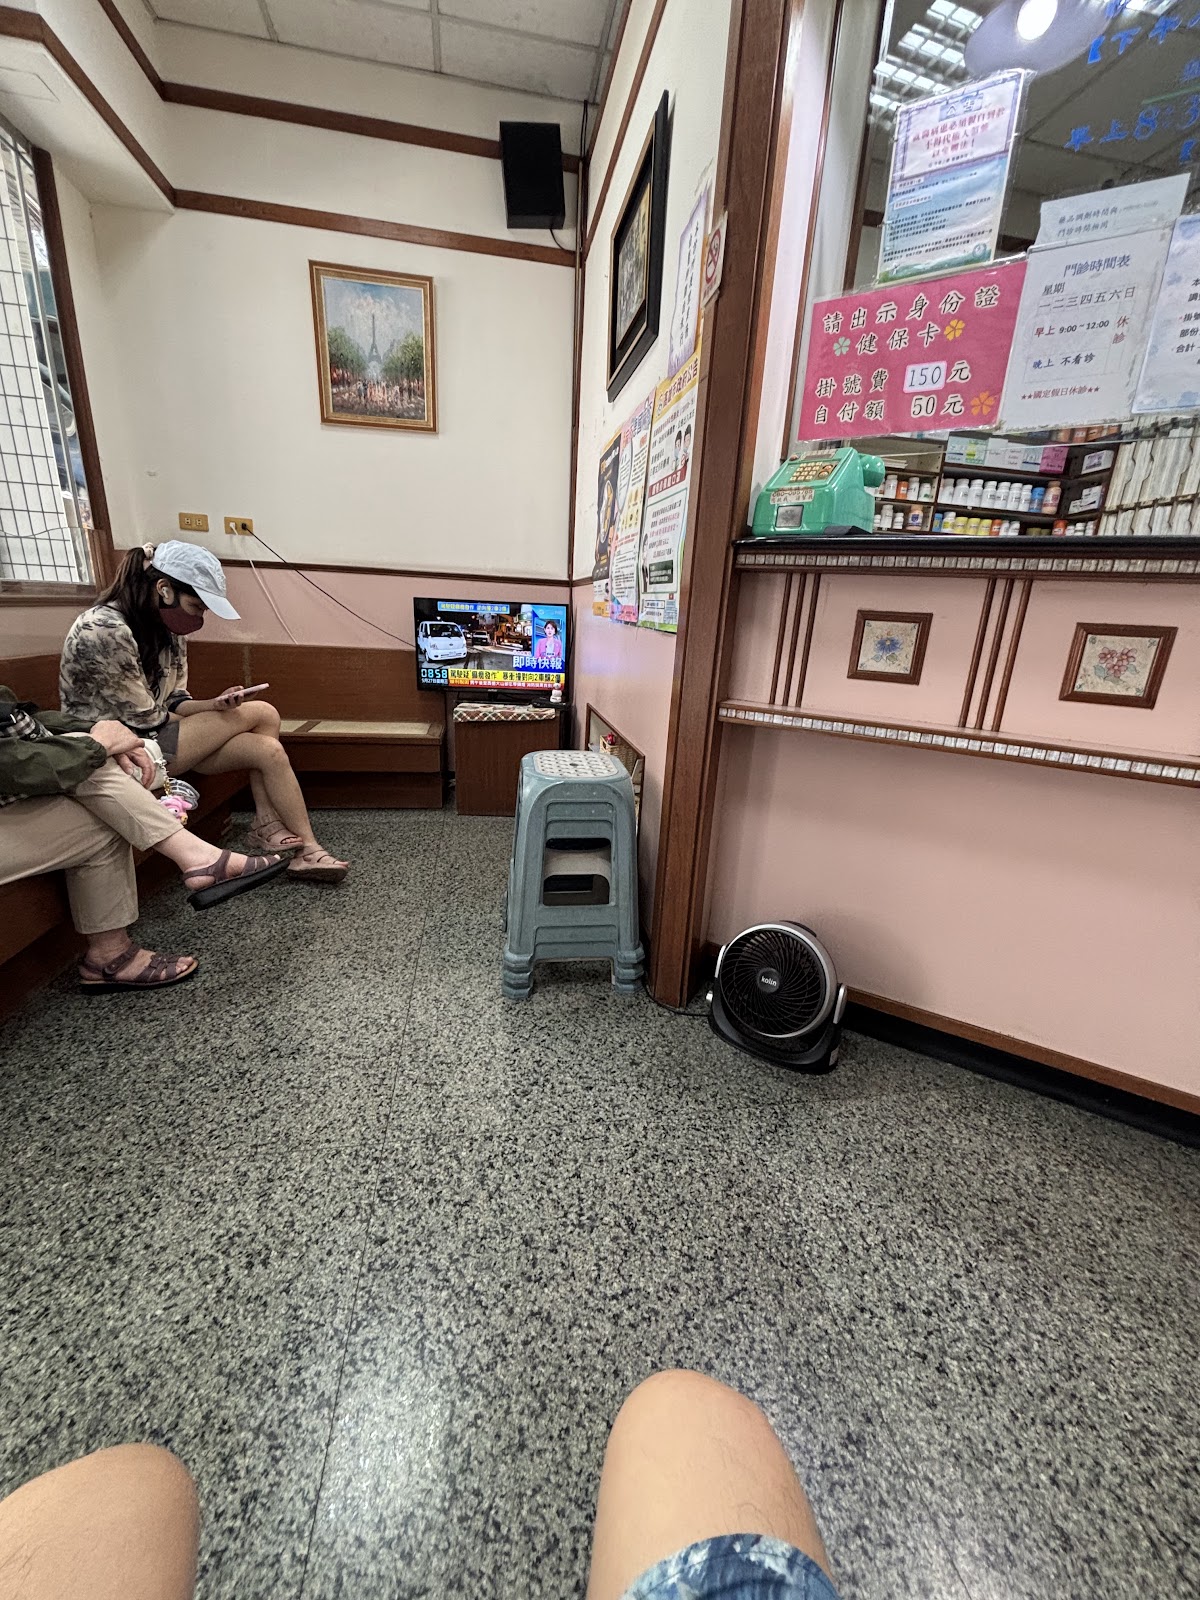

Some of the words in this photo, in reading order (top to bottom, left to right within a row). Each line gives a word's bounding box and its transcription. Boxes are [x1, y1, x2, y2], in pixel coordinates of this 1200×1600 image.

[1063, 254, 1131, 278] 門診時間表
[1039, 286, 1136, 309] 一二三四五六日
[1041, 282, 1066, 296] 星期
[823, 284, 999, 334] 請出示身份證
[856, 323, 940, 354] 健保卡
[1034, 325, 1055, 338] 早上
[1032, 358, 1055, 370] 晚上
[1060, 352, 1096, 366] 不看診
[816, 368, 888, 398] 掛號費
[815, 401, 884, 424] 自付額
[513, 655, 562, 670] 即時快報
[421, 669, 448, 679] 0858
[760, 975, 777, 987] kolin
